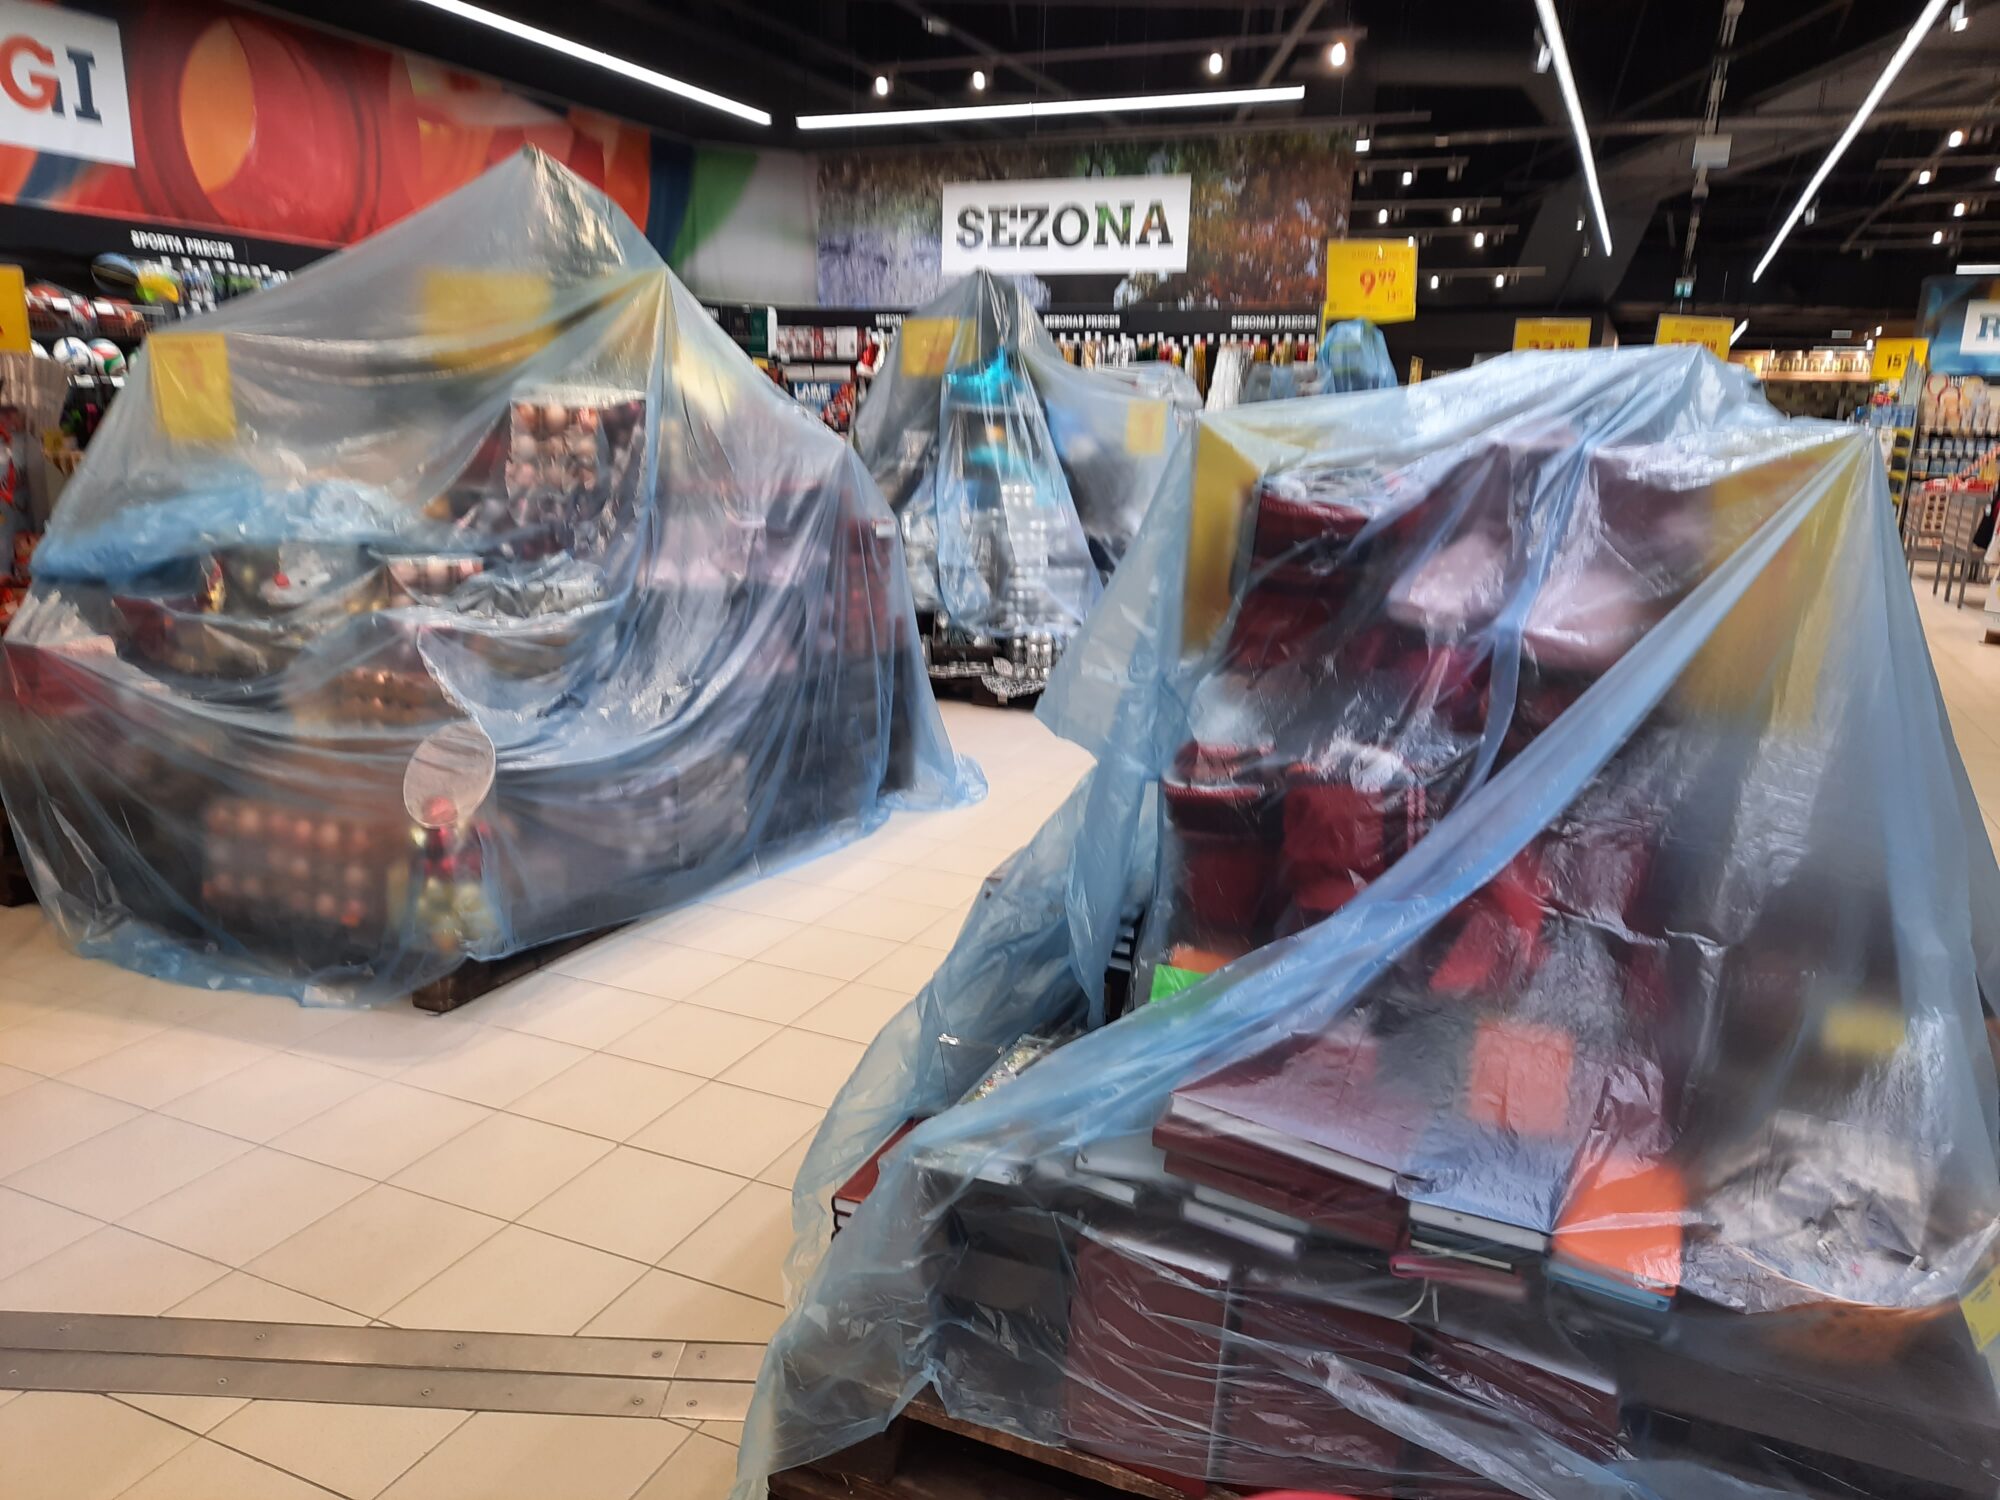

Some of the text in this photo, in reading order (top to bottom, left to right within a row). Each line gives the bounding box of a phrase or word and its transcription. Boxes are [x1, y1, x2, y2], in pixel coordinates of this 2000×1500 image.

[956, 199, 1174, 249] SEZONA
[130, 230, 185, 254] SPORTA
[1043, 314, 1120, 329] SEZONAS PRECES
[1231, 315, 1317, 330] SEZONAS PRECES
